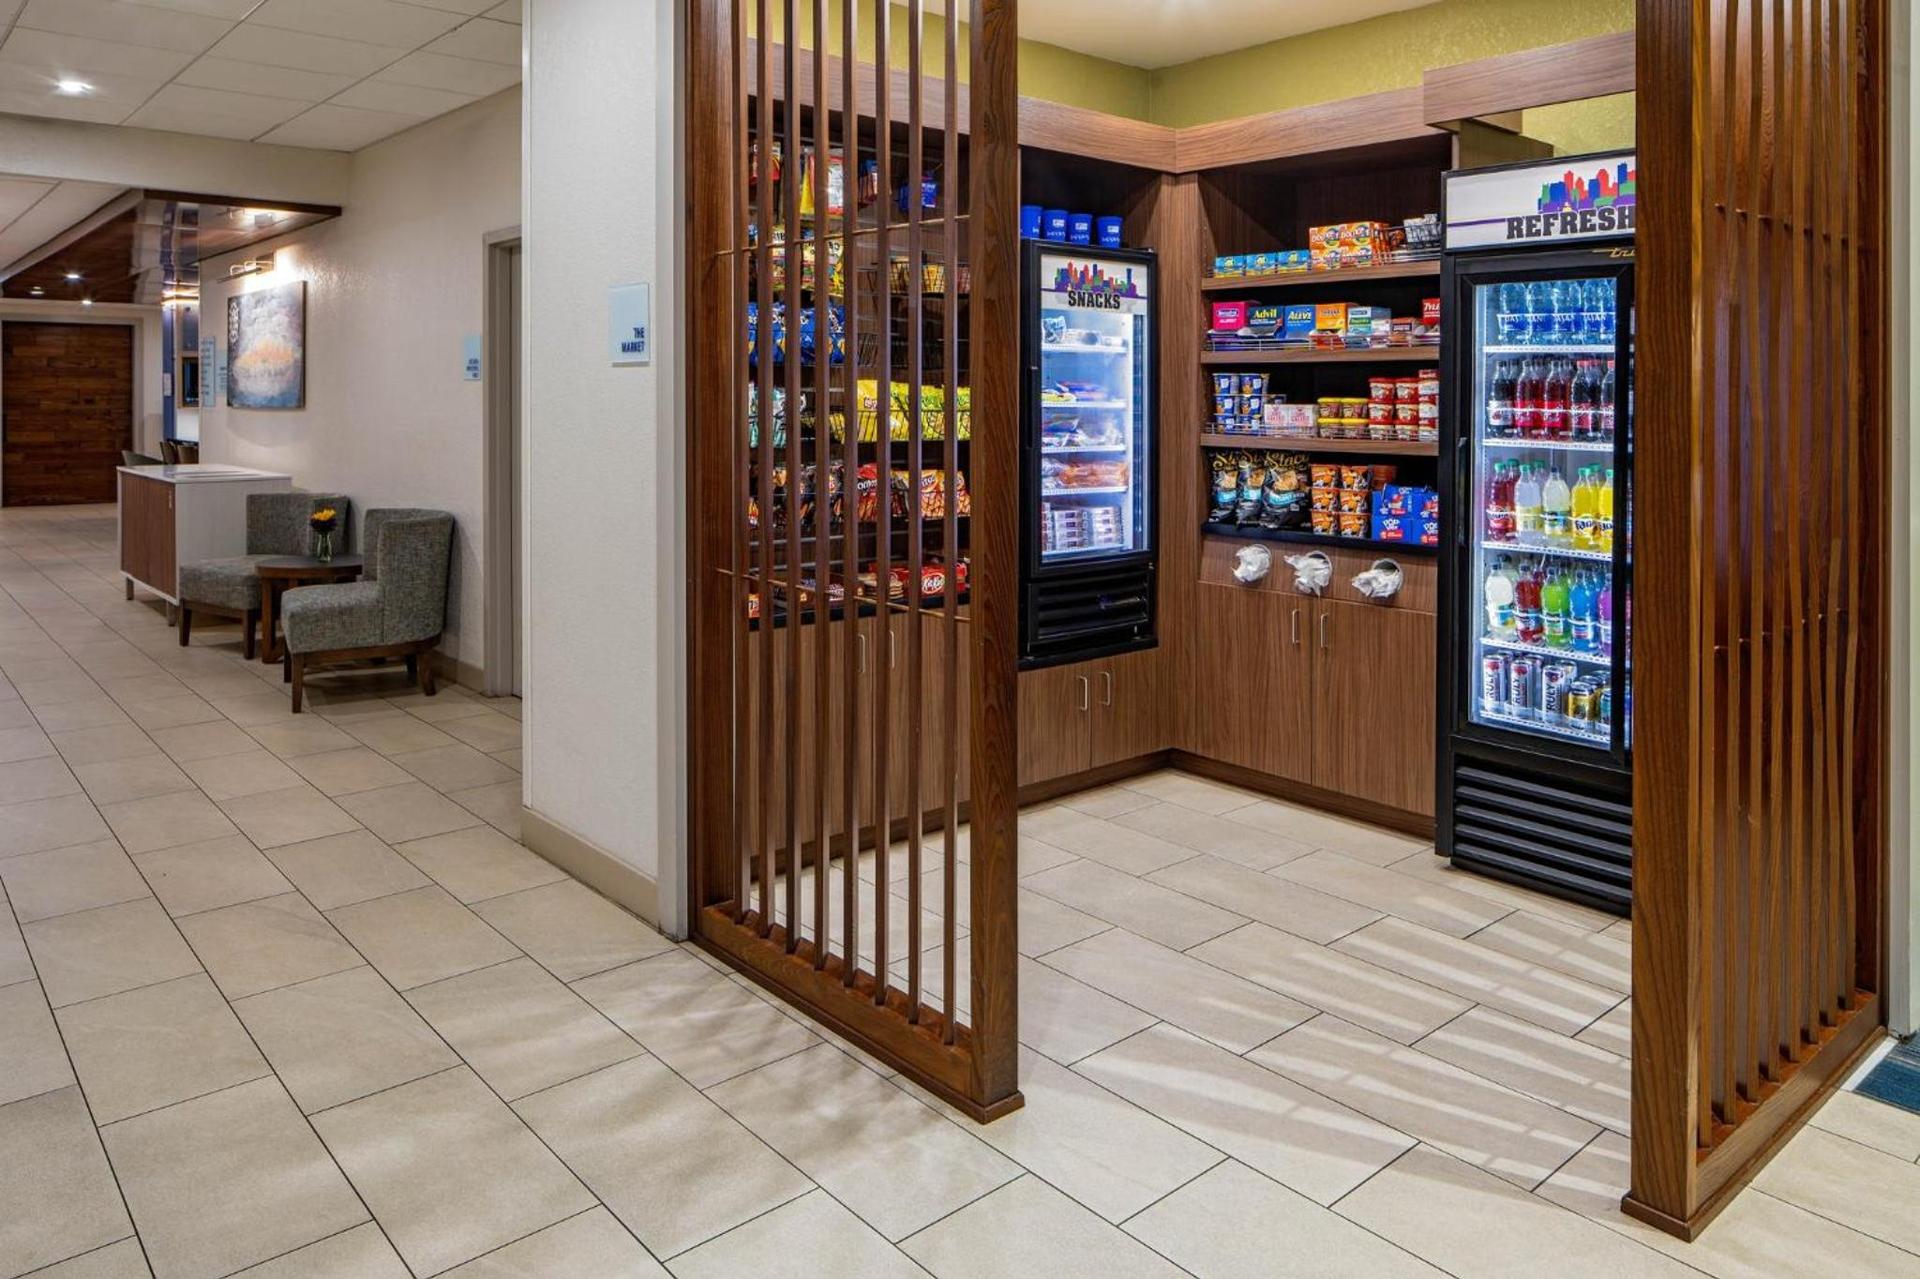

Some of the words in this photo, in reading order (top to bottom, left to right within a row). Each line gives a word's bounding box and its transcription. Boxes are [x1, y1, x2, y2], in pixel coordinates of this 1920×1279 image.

[1068, 290, 1121, 310] SNACKS
[1253, 308, 1277, 319] Advil
[633, 327, 645, 339] THE
[621, 341, 645, 353] MARKET
